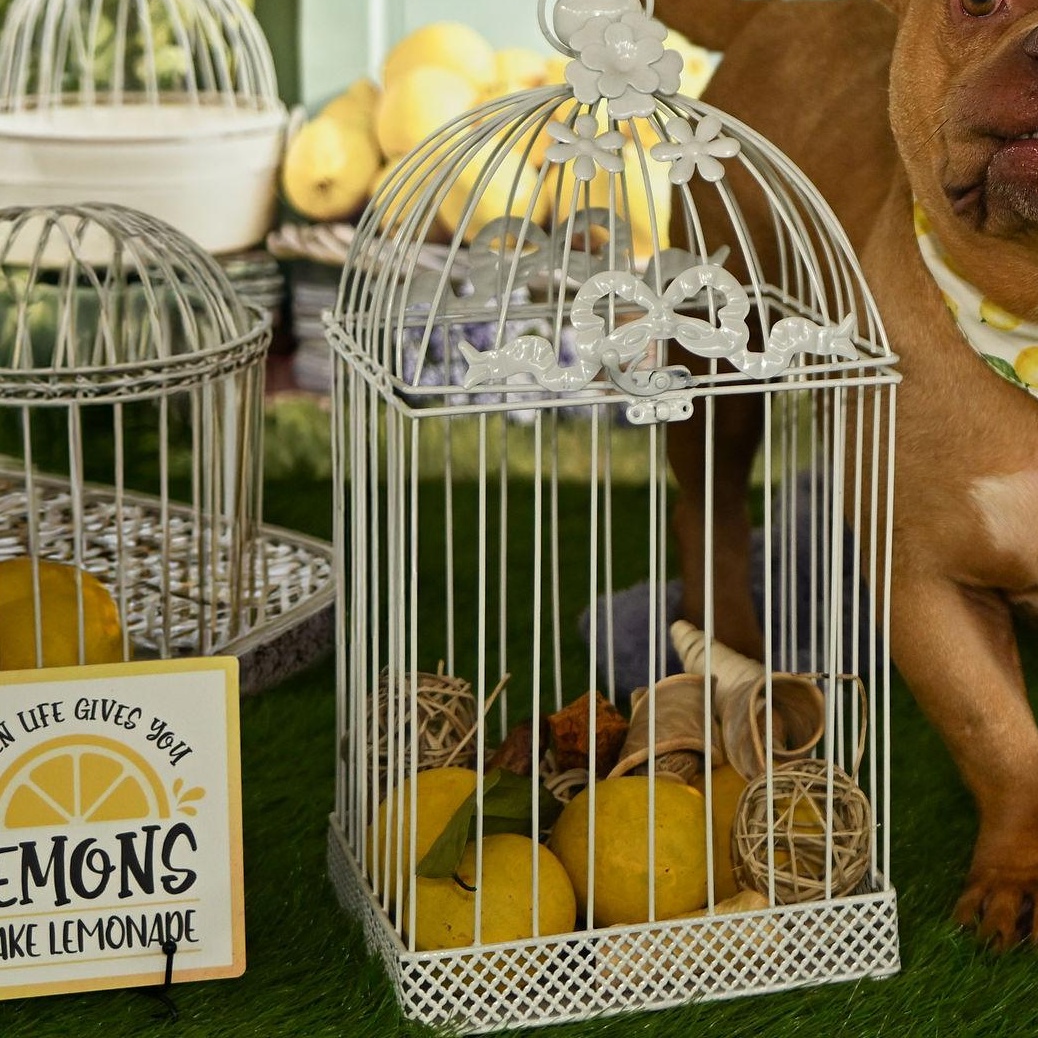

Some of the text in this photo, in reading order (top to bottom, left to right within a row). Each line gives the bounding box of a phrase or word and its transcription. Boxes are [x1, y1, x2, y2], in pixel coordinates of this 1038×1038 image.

[17, 700, 66, 734] LIFE
[74, 697, 143, 731] GIVES
[146, 717, 194, 767] YOU
[49, 909, 200, 956] LEMONADE
